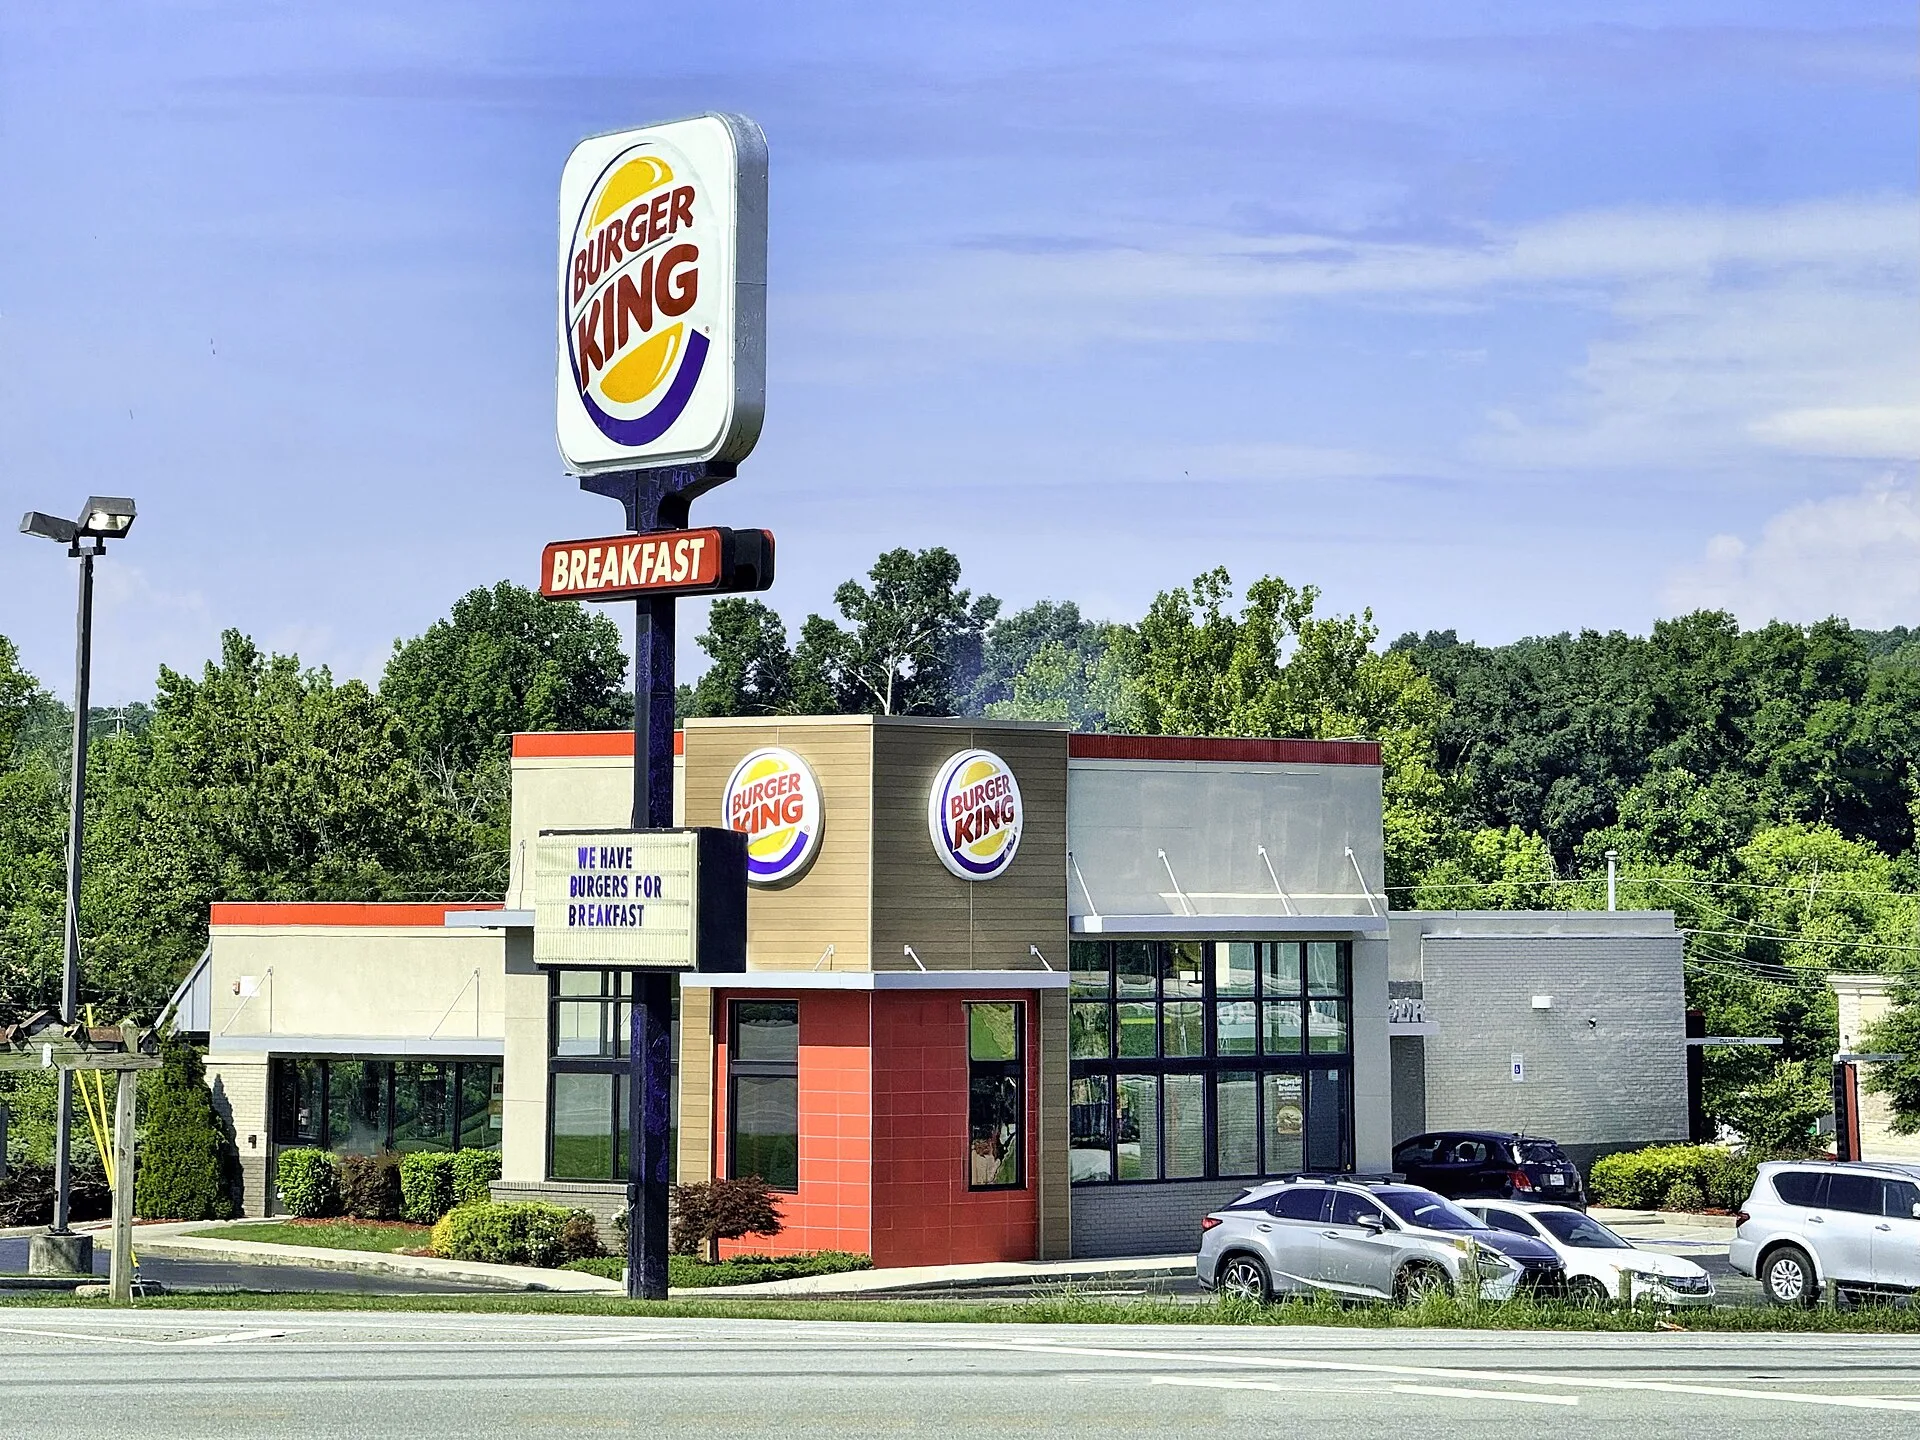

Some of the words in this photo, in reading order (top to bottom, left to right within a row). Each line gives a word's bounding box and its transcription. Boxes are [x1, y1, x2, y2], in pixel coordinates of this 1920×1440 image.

[573, 185, 696, 308] BURGER
[578, 243, 699, 390] KING
[550, 537, 705, 592] BREAKFAST
[732, 772, 801, 816] BURGER
[951, 774, 1012, 820] BURGER
[953, 794, 1014, 850] KING
[578, 847, 596, 869] WE
[600, 847, 633, 869] HAVE
[570, 875, 628, 898] BURGERS
[635, 875, 662, 898] FOR
[568, 904, 645, 927] BREAKFAST
